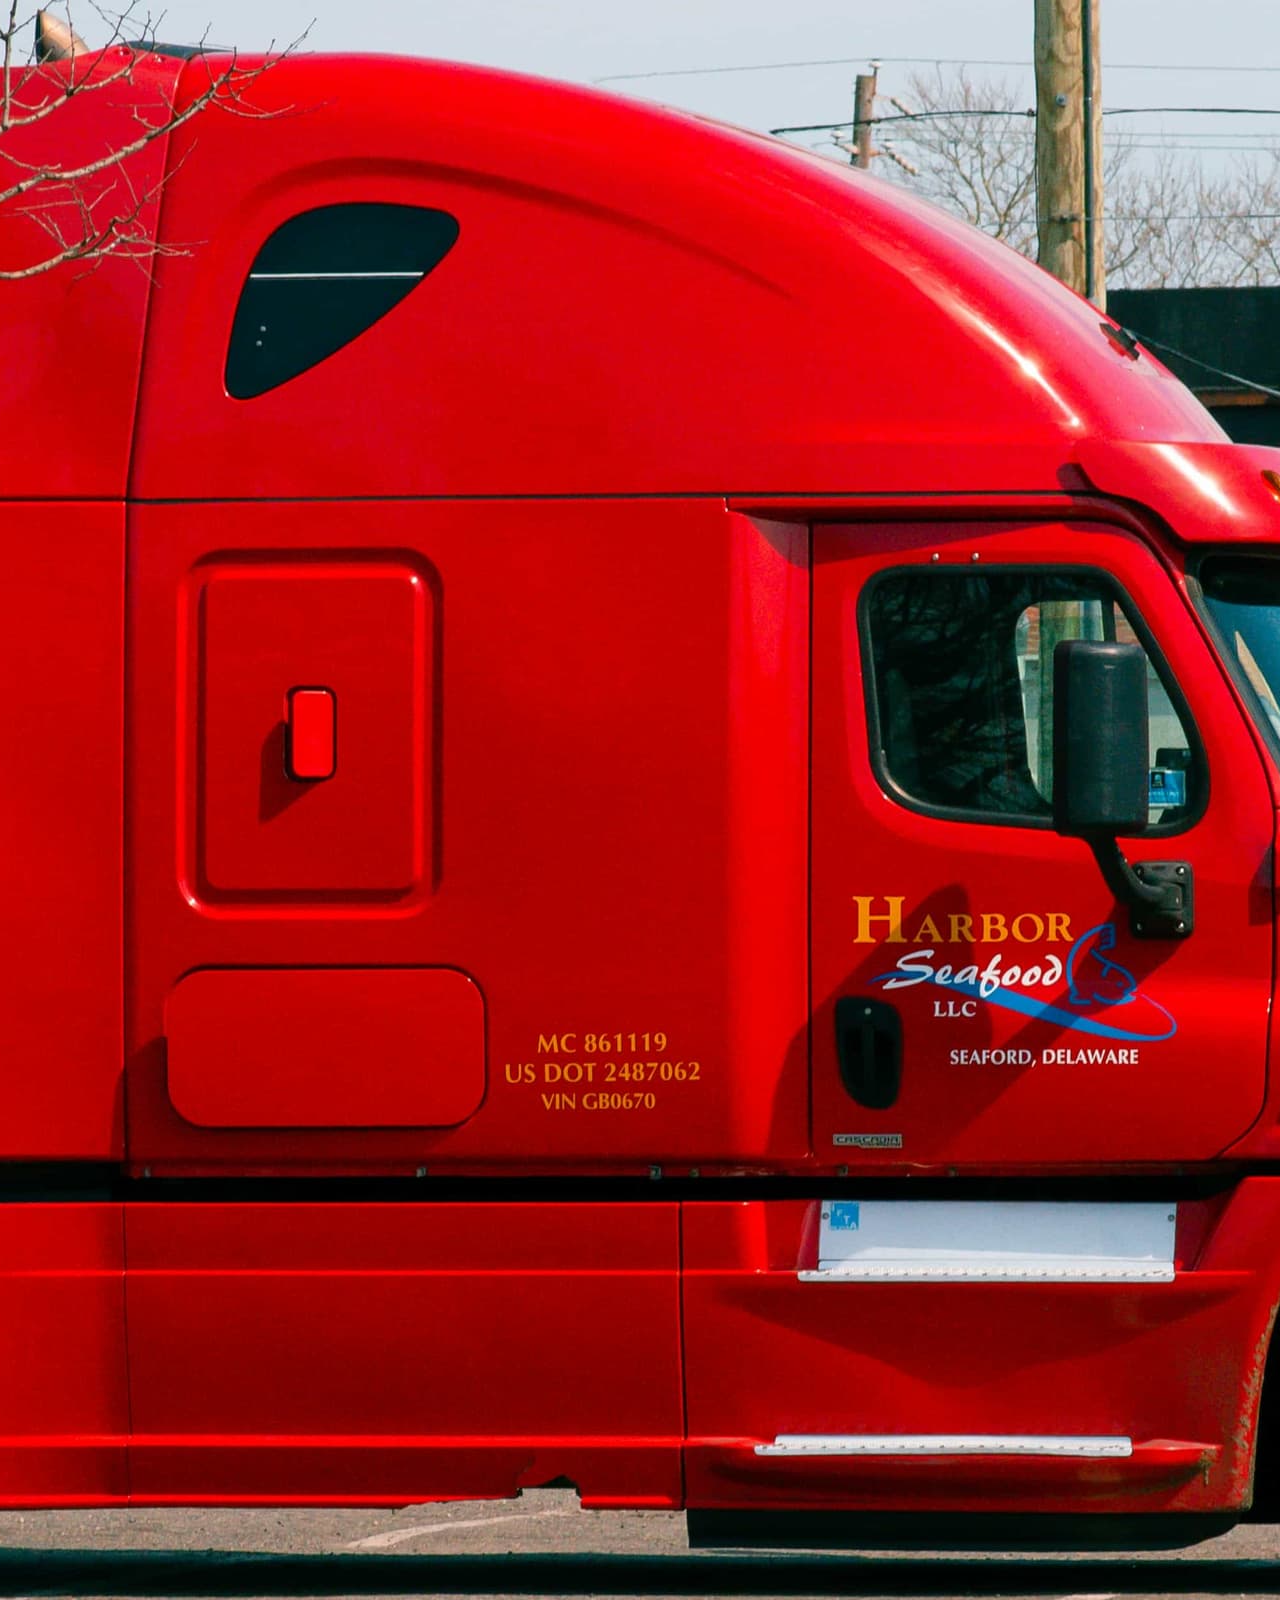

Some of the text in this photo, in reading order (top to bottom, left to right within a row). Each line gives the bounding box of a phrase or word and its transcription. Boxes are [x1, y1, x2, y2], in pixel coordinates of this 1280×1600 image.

[852, 896, 1073, 943] HARBOR
[882, 950, 1063, 998] Seafood
[933, 1000, 977, 1017] LLC
[537, 1032, 667, 1053] MC 861119
[950, 1048, 1139, 1067] SEAFORD, DELAWARE
[505, 1061, 701, 1083] US DOT 2487062
[541, 1092, 656, 1111] VIN GB0670
